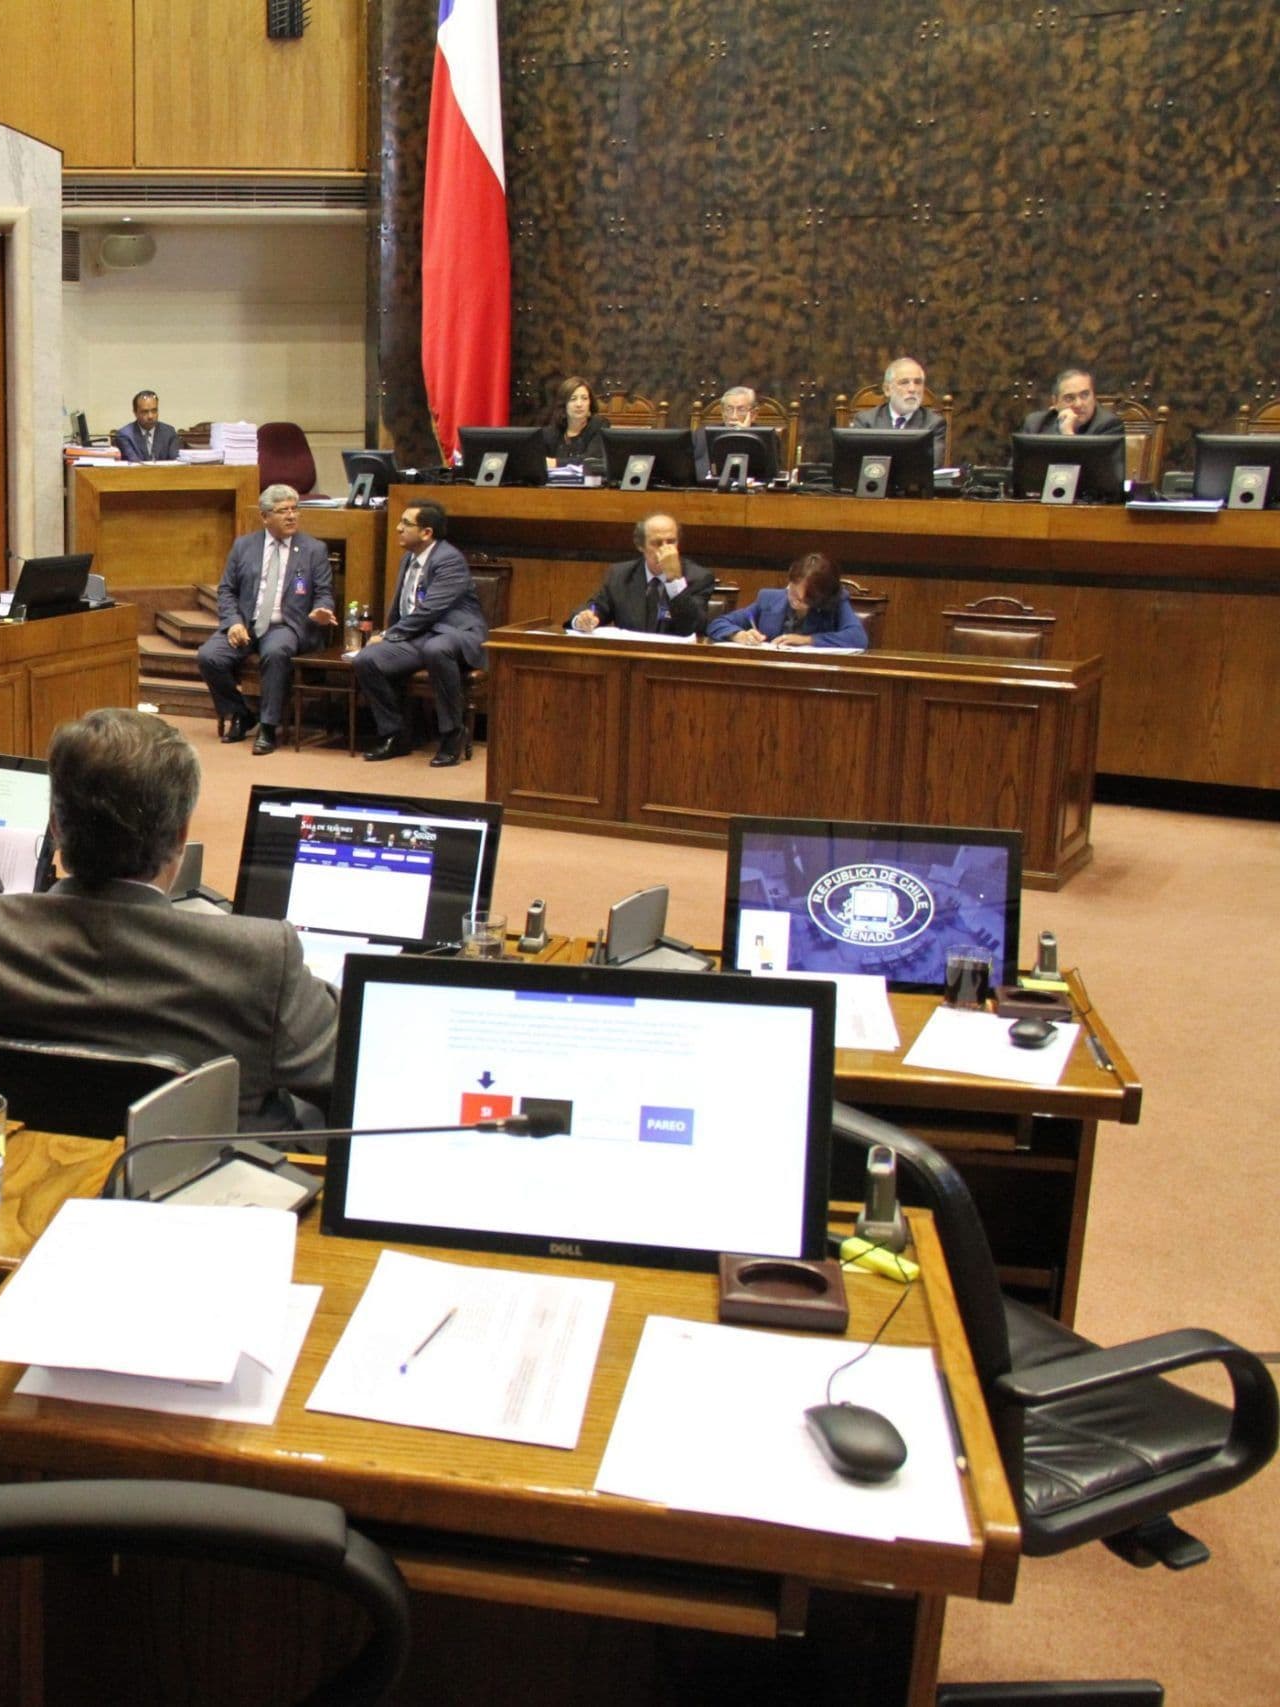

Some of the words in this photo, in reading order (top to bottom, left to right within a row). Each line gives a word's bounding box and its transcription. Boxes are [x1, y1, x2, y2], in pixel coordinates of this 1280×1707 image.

[812, 868, 877, 904] REPUBLICA
[879, 870, 898, 883] DE
[898, 877, 929, 910] CHILE
[841, 927, 895, 942] SENADO
[646, 1118, 686, 1132] PAREO
[549, 1242, 583, 1257] DELL
